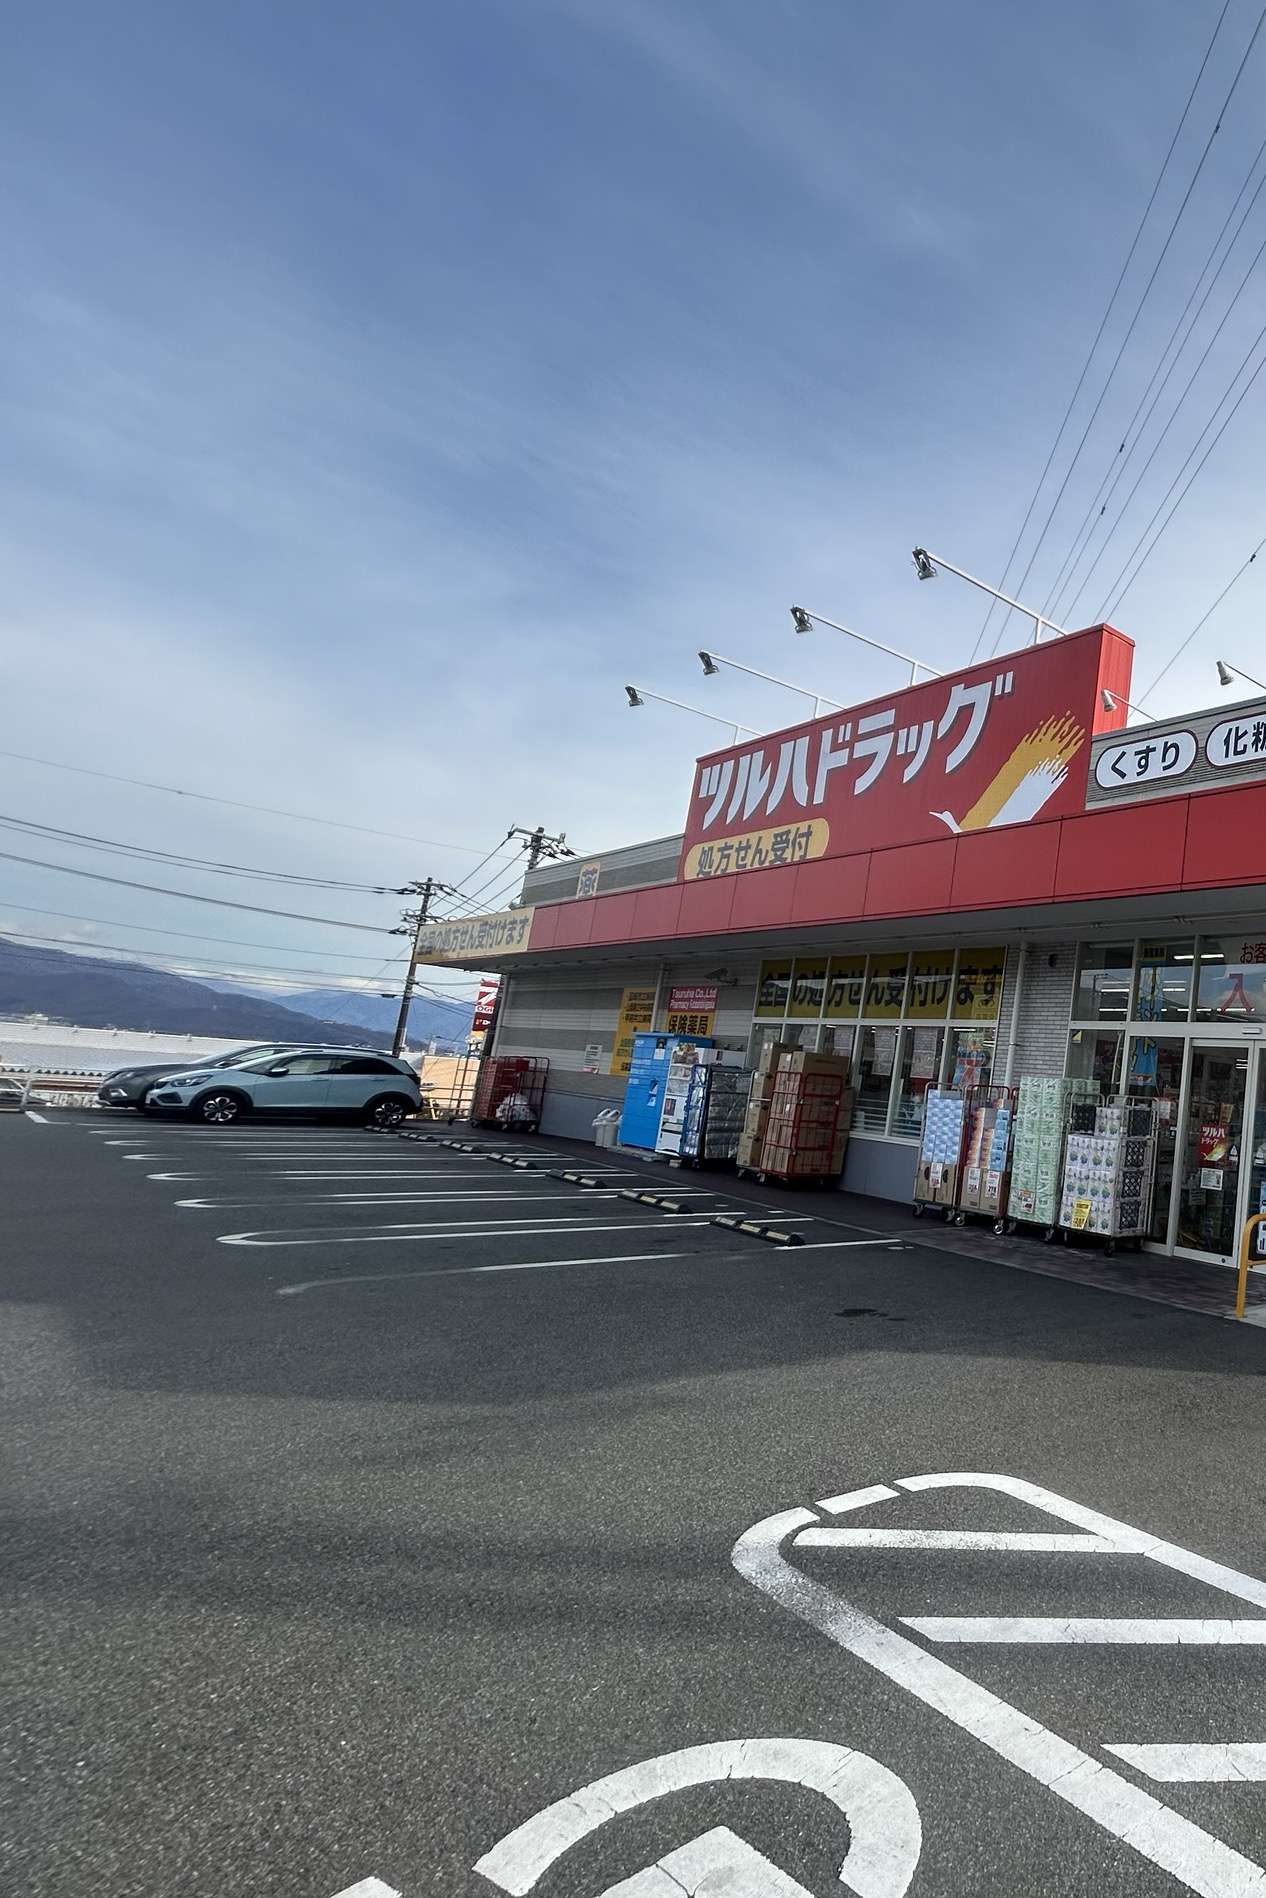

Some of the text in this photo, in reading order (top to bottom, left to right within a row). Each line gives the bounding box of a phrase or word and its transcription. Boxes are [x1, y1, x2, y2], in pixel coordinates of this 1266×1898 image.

[698, 670, 1015, 830] ツルハドラッグ
[1110, 740, 1180, 780] くすり
[696, 823, 814, 878] 処方せん受付
[416, 915, 530, 956] 全国の処方せん受付けます
[671, 987, 695, 999] Tsuruha
[758, 963, 1004, 1008] 全国の処方せん受付けます
[668, 1014, 709, 1036] 保険薬局
[1201, 1137, 1219, 1147] ドラッグ
[1202, 1126, 1226, 1138] ツルハ
